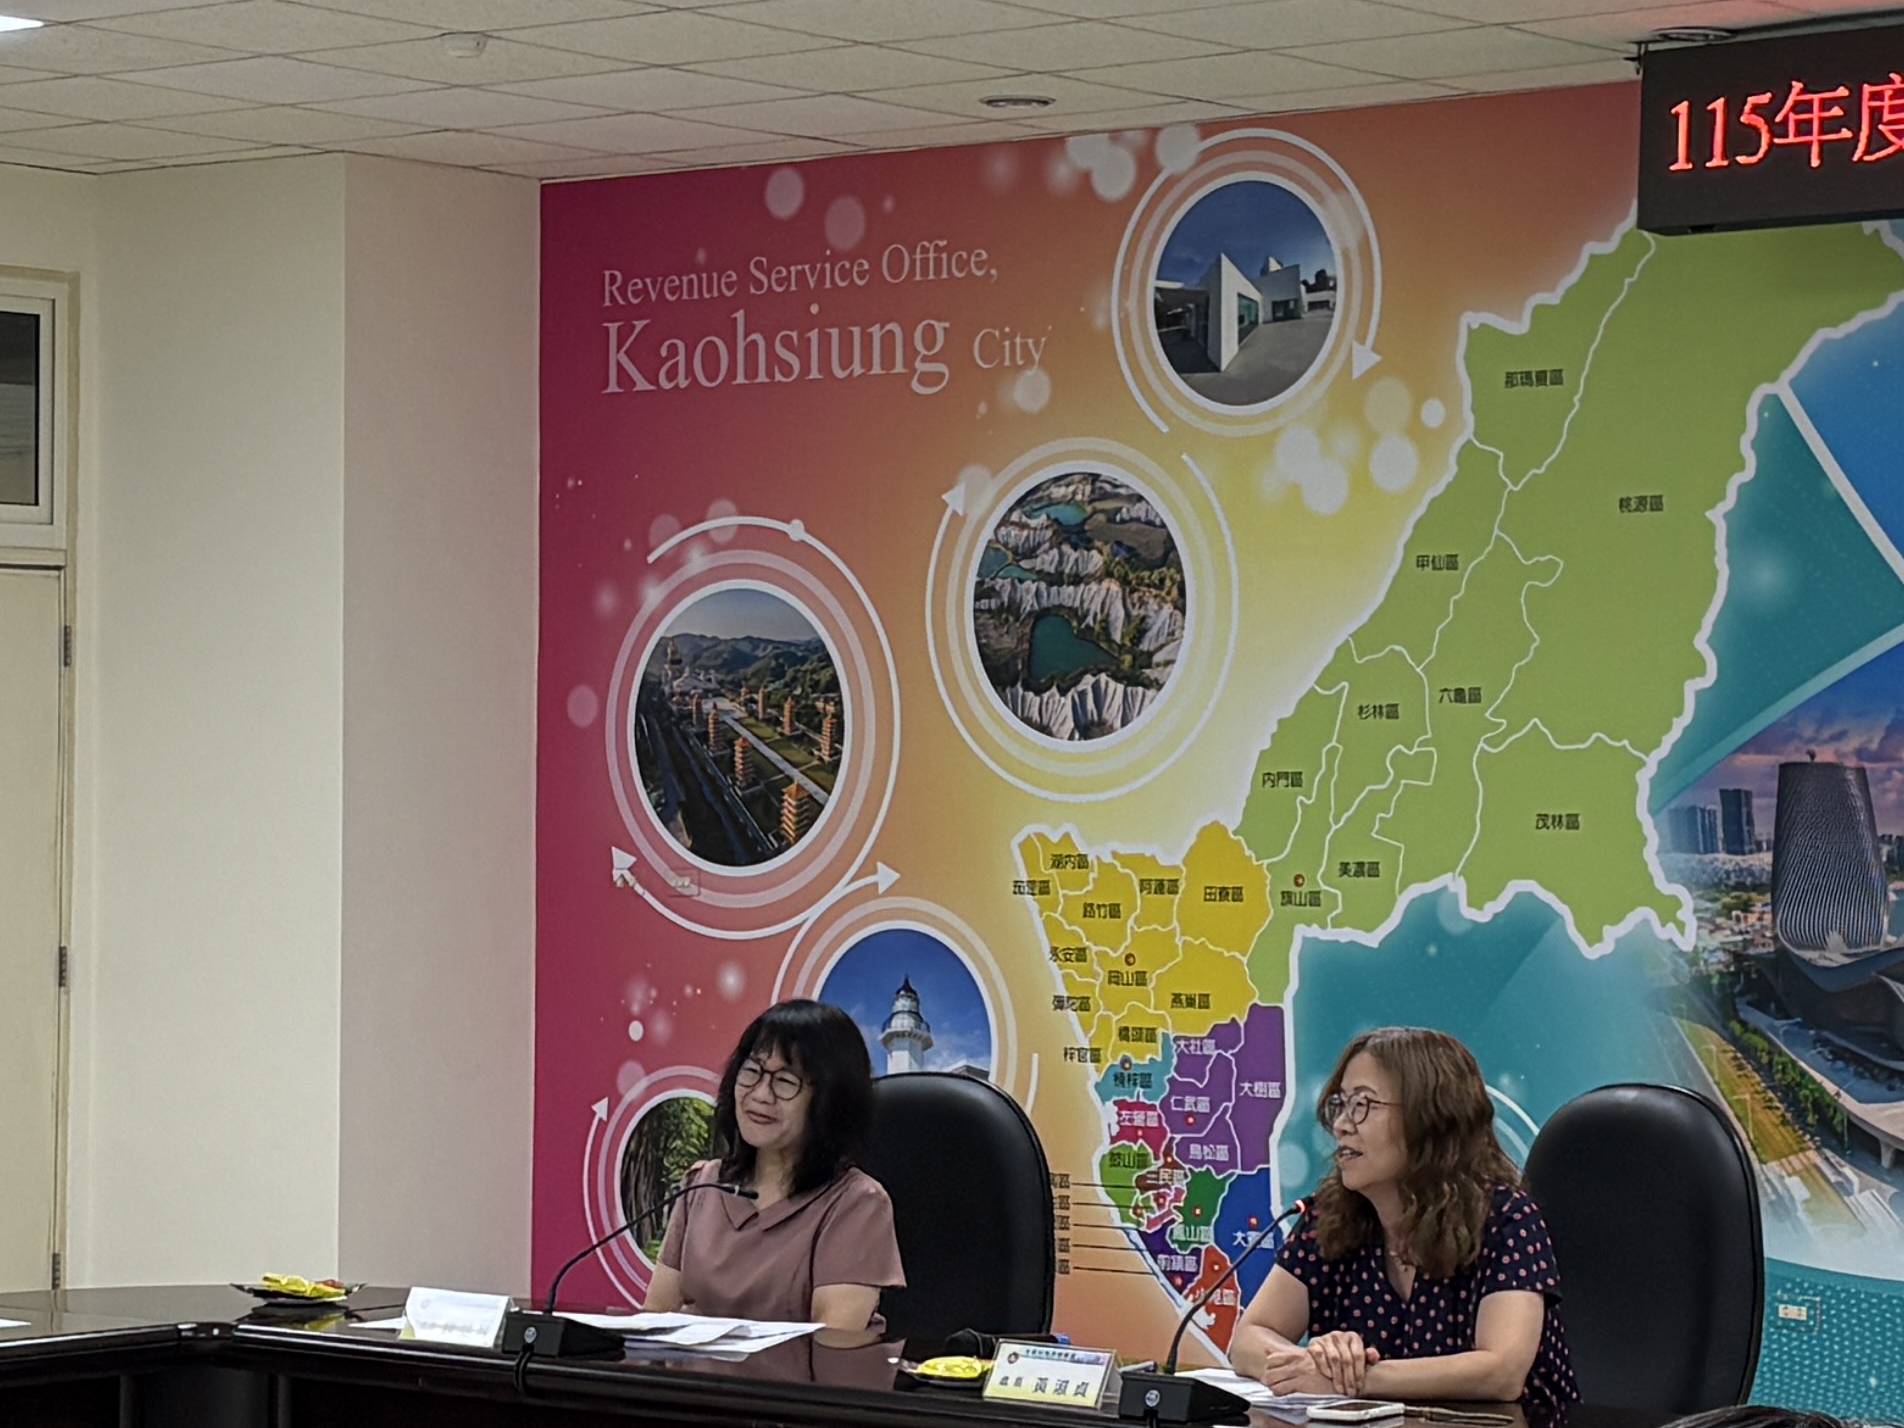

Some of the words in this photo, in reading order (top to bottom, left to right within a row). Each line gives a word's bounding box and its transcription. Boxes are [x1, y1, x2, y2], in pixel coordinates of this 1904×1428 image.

[602, 267, 738, 307] Revenue
[748, 249, 870, 296] Service
[881, 239, 998, 284] Office,
[601, 302, 950, 396] Kaohsiung
[973, 326, 1049, 370] City
[1505, 369, 1564, 388] 那瑪夏區
[1618, 495, 1664, 513] 桃源區
[1415, 553, 1460, 571] 甲仙區
[1438, 686, 1482, 704] 六龜區
[1358, 703, 1400, 720] 杉林區
[1262, 770, 1303, 788] 內門區
[1535, 813, 1580, 831] 茂林區
[1337, 861, 1380, 879] 美濃區
[1139, 878, 1180, 895] 阿蓮區
[1203, 886, 1244, 903] 田寮區
[1280, 889, 1322, 908] 旗山區
[1082, 903, 1122, 919] 路竹區
[1048, 946, 1088, 963] 永安區
[1107, 970, 1148, 987] 岡山區
[1170, 992, 1211, 1010] 燕巢區
[1063, 1047, 1102, 1063] 梓官區
[1175, 1038, 1216, 1055] 大社區
[1239, 1081, 1281, 1099] 大樹區
[1170, 1096, 1211, 1113] 仁武區
[1119, 1110, 1159, 1127] 左營區
[1188, 1144, 1229, 1162] 鳥松區
